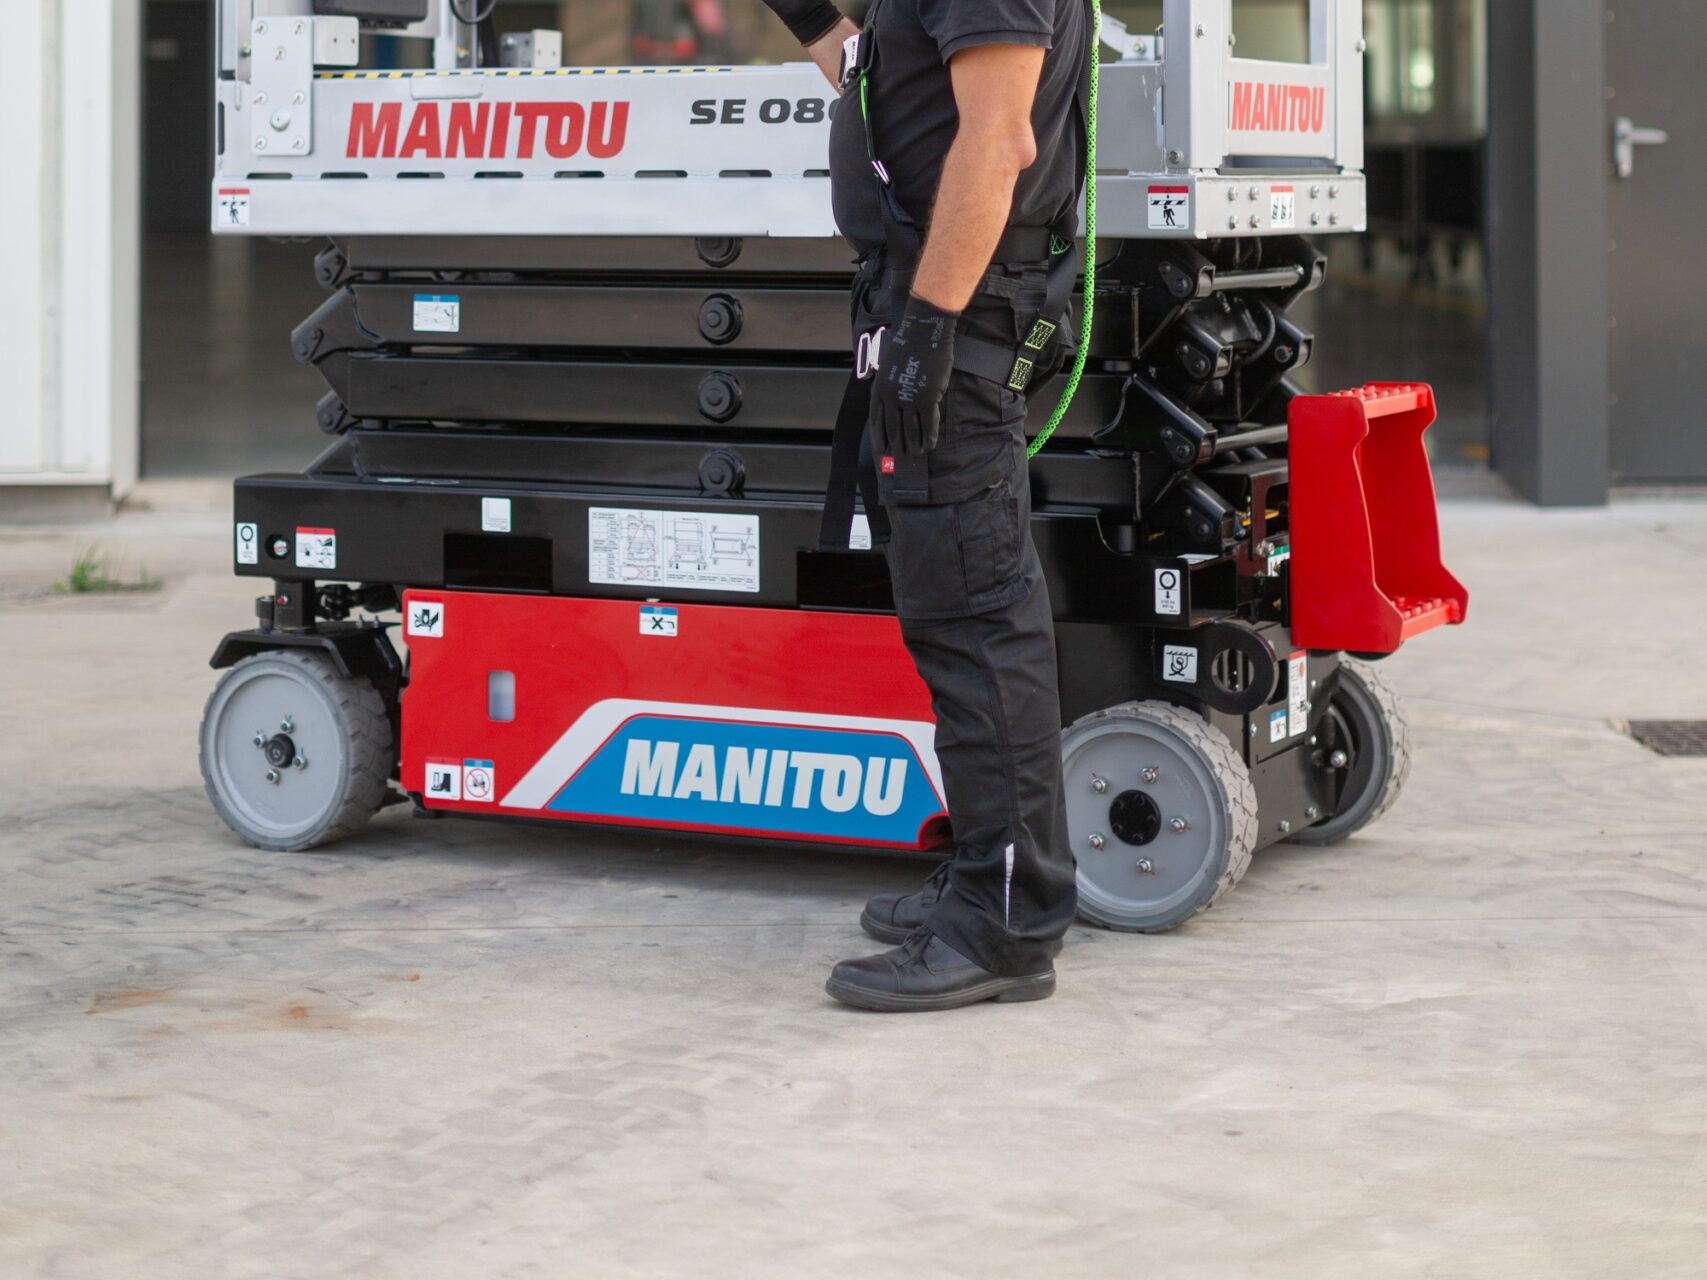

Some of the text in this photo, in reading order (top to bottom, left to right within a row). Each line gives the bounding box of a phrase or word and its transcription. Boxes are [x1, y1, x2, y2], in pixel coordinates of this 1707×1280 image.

[346, 101, 630, 159] MANITOU
[690, 99, 747, 125] SE
[1231, 82, 1325, 134] MANITOU
[619, 738, 908, 817] MANITOU
